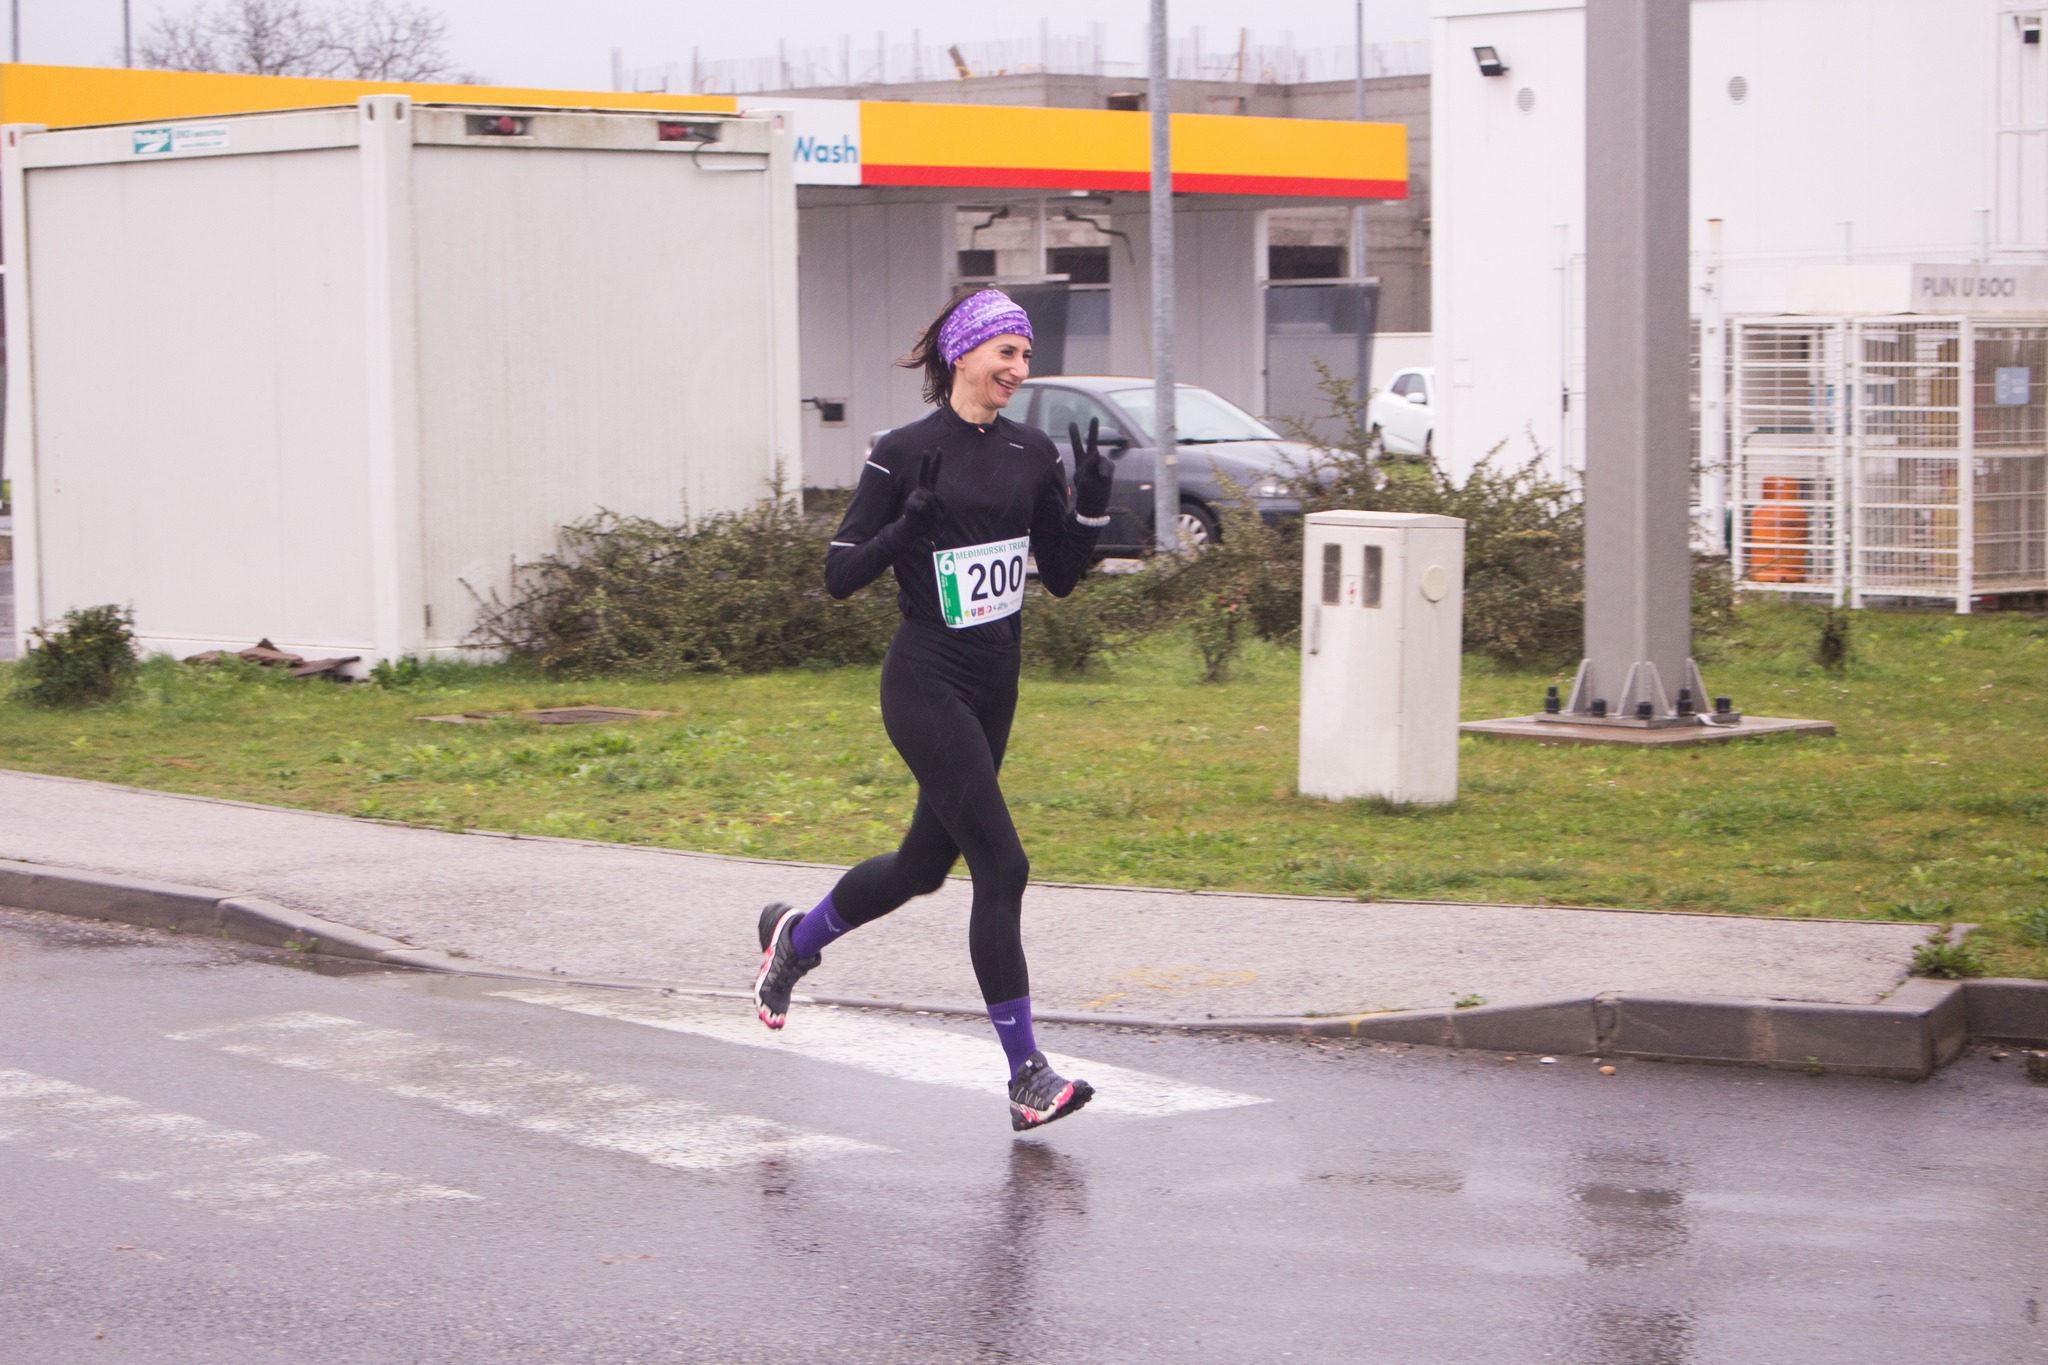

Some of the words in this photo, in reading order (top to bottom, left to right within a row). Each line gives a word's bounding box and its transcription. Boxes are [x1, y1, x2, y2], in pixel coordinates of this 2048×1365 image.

[1922, 277, 1957, 297] PLIN
[1961, 277, 1974, 297] U
[967, 555, 1023, 602] 200
